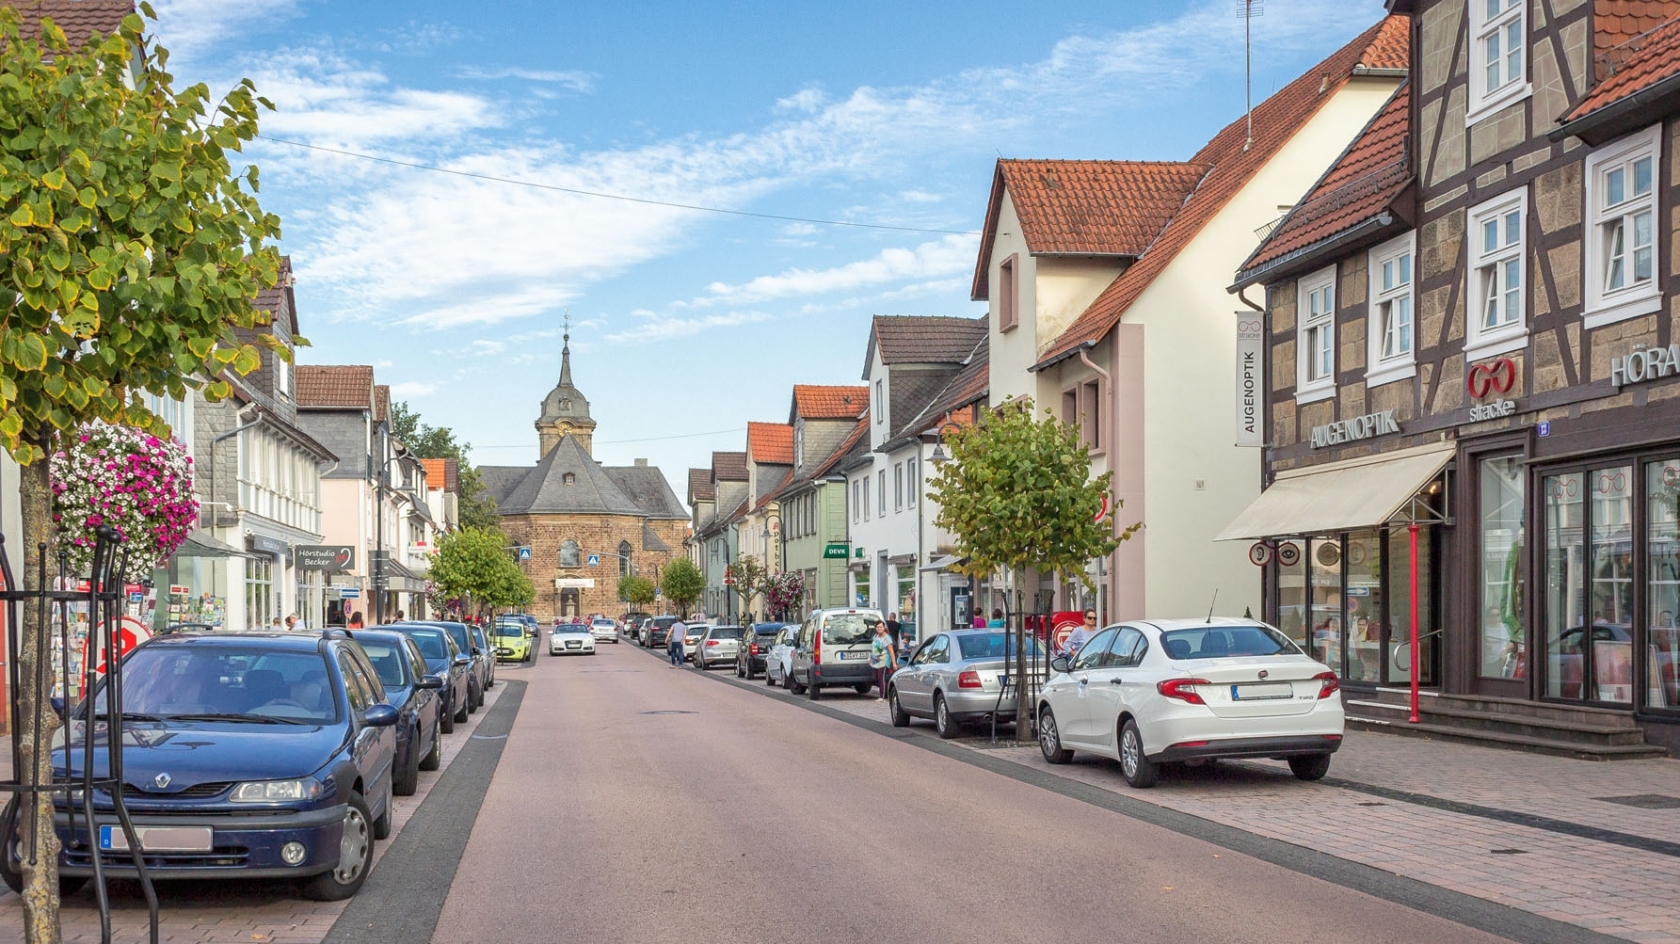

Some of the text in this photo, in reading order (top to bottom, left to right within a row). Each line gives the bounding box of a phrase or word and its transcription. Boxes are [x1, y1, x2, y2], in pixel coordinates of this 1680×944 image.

[1244, 351, 1255, 433] AUGENOPTIK
[1469, 399, 1516, 422] stracke
[1310, 408, 1400, 448] AUGENOPTIK
